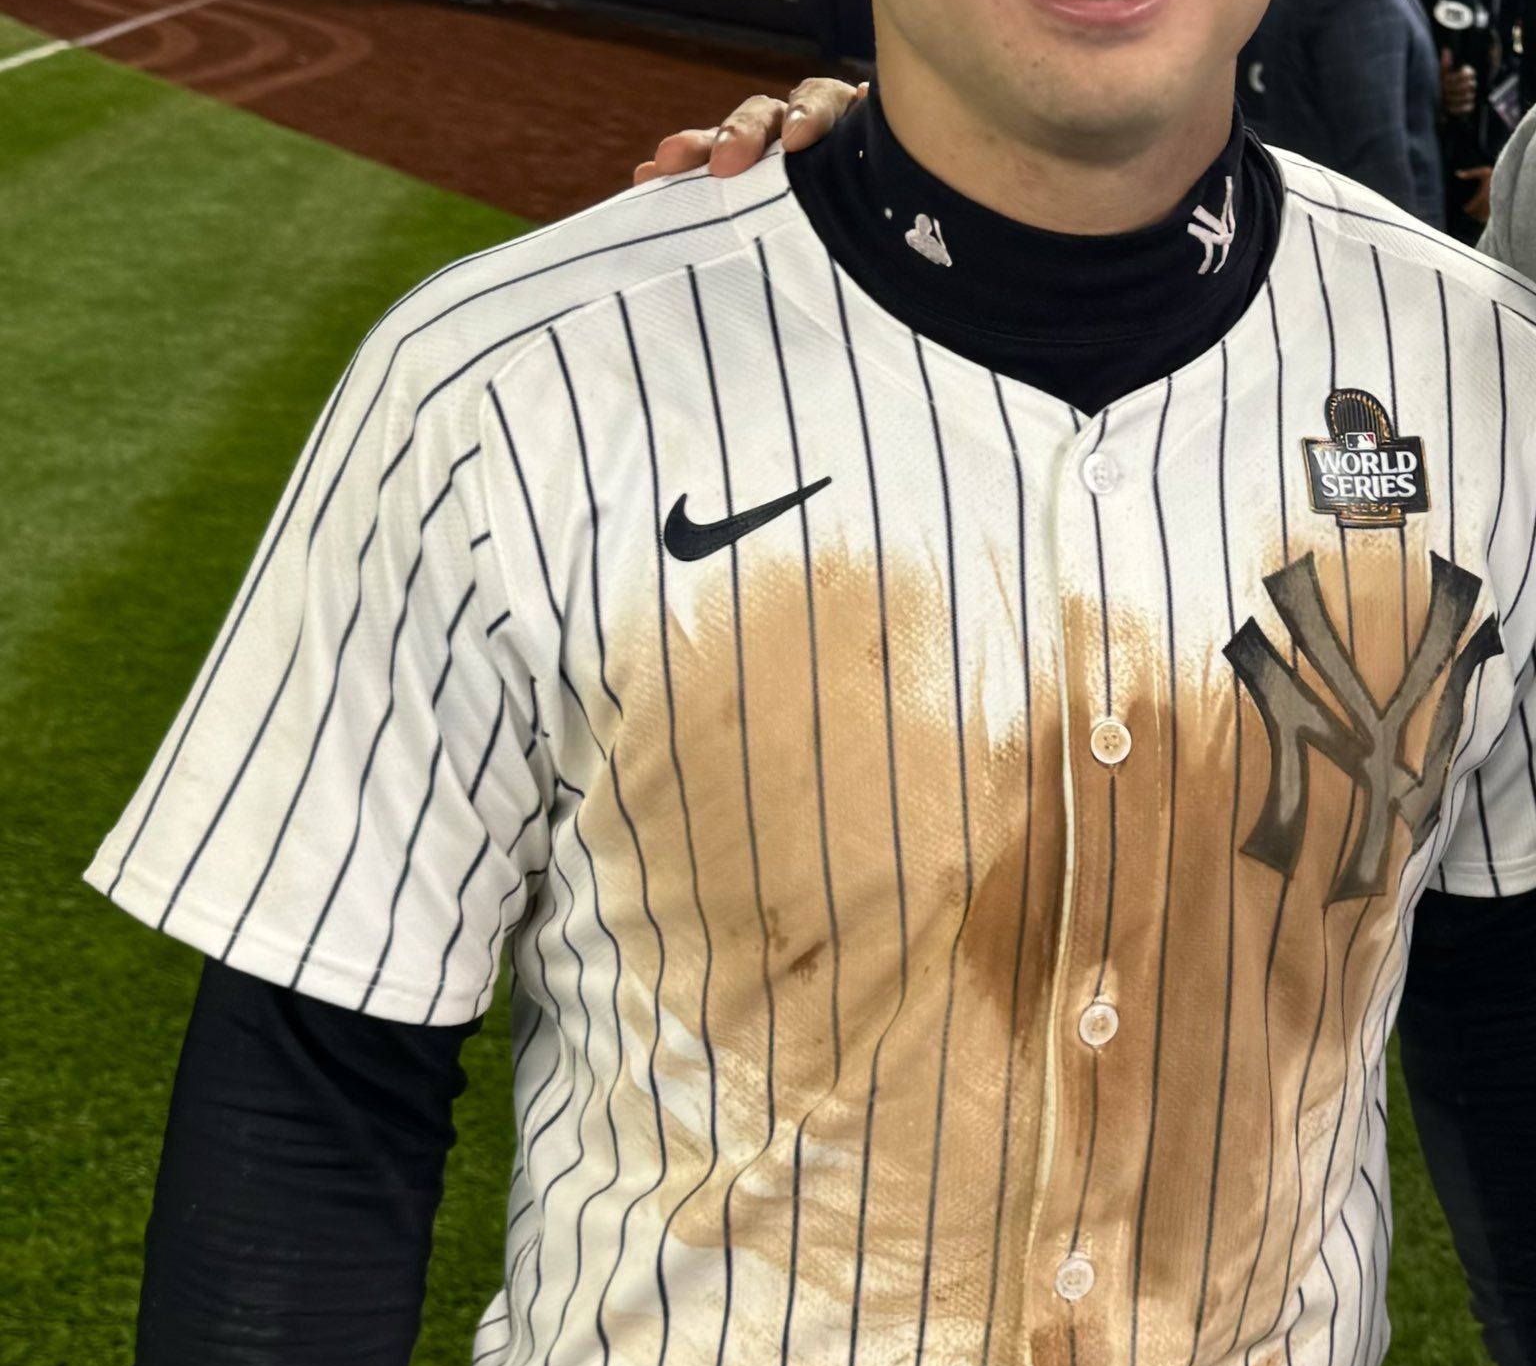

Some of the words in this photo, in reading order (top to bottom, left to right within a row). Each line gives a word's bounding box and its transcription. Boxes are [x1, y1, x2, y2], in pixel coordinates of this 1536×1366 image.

[1312, 450, 1418, 474] WORLD
[1321, 473, 1417, 501] SERIES
[1221, 551, 1504, 908] NY
